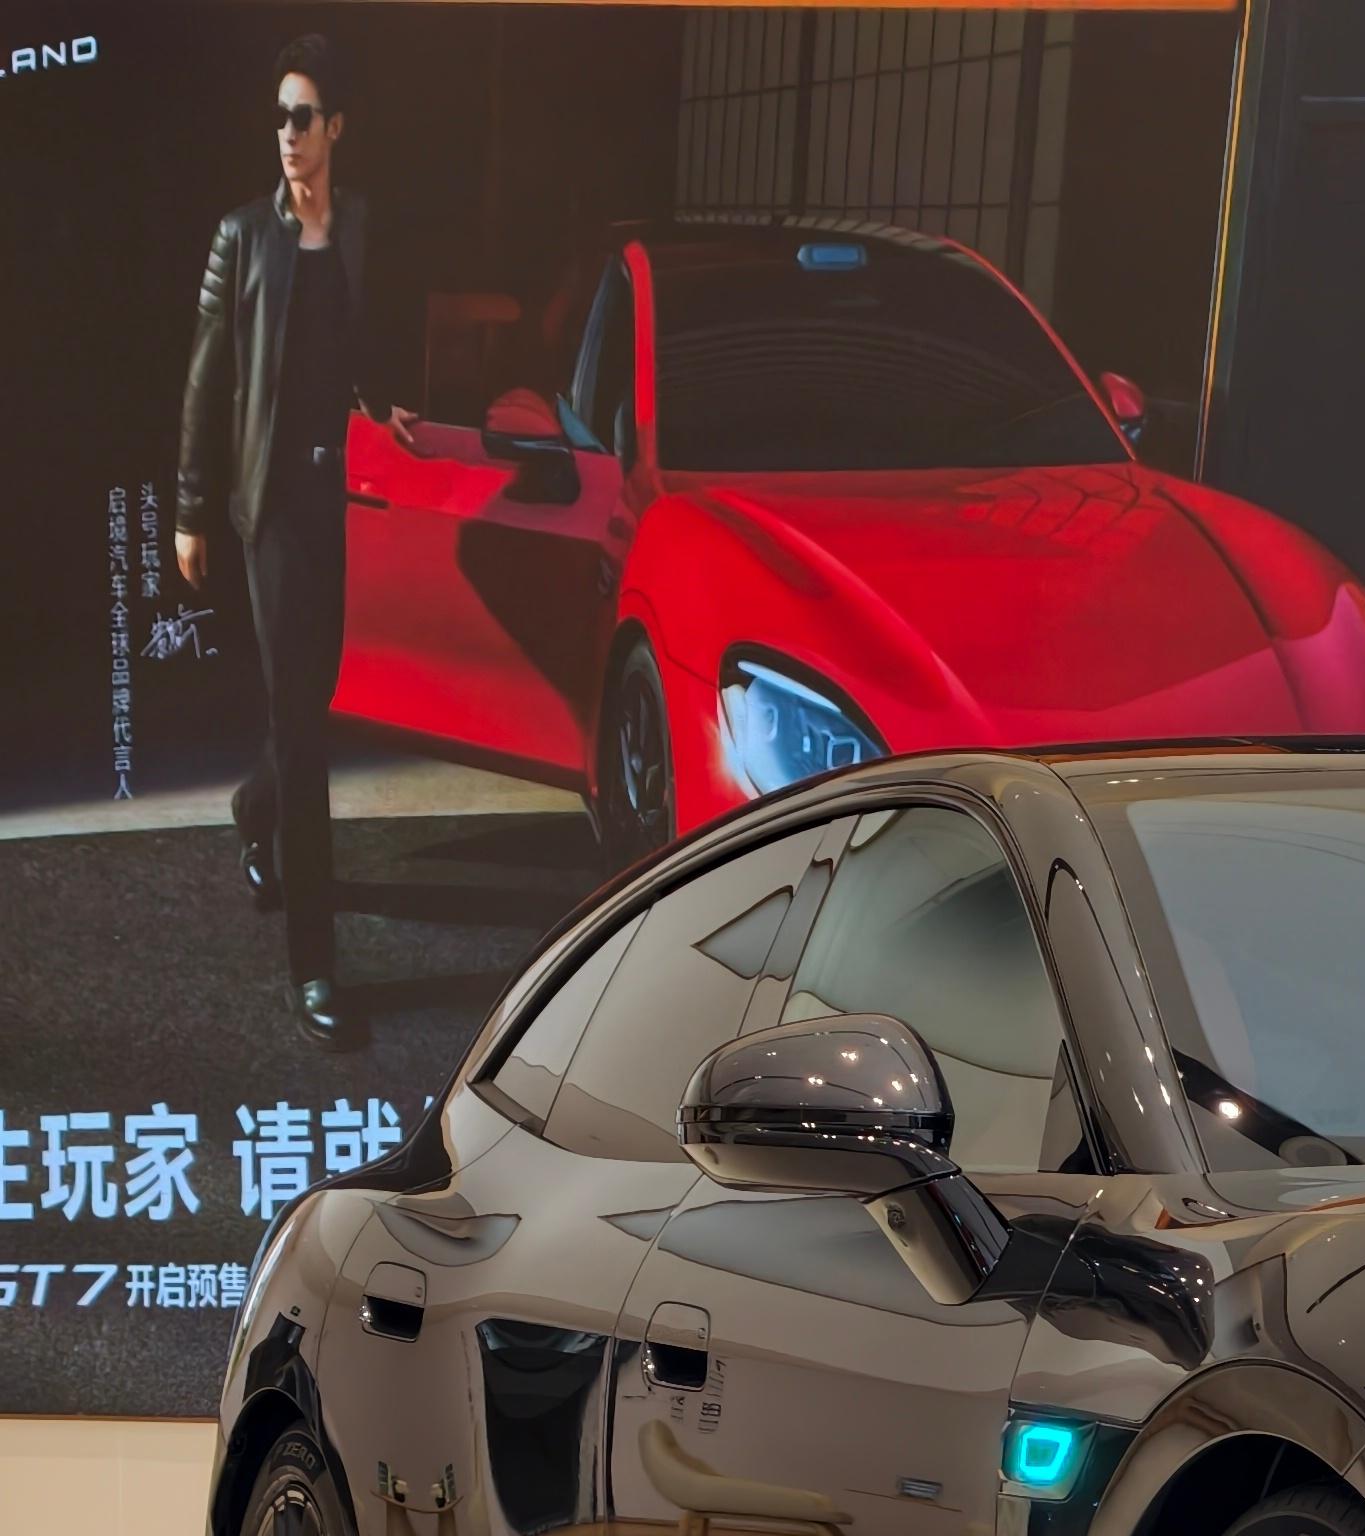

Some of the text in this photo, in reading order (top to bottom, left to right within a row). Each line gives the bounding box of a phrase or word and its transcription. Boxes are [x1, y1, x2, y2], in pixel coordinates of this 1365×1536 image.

[0, 36, 98, 77] AND
[140, 482, 161, 597] 头号玩家
